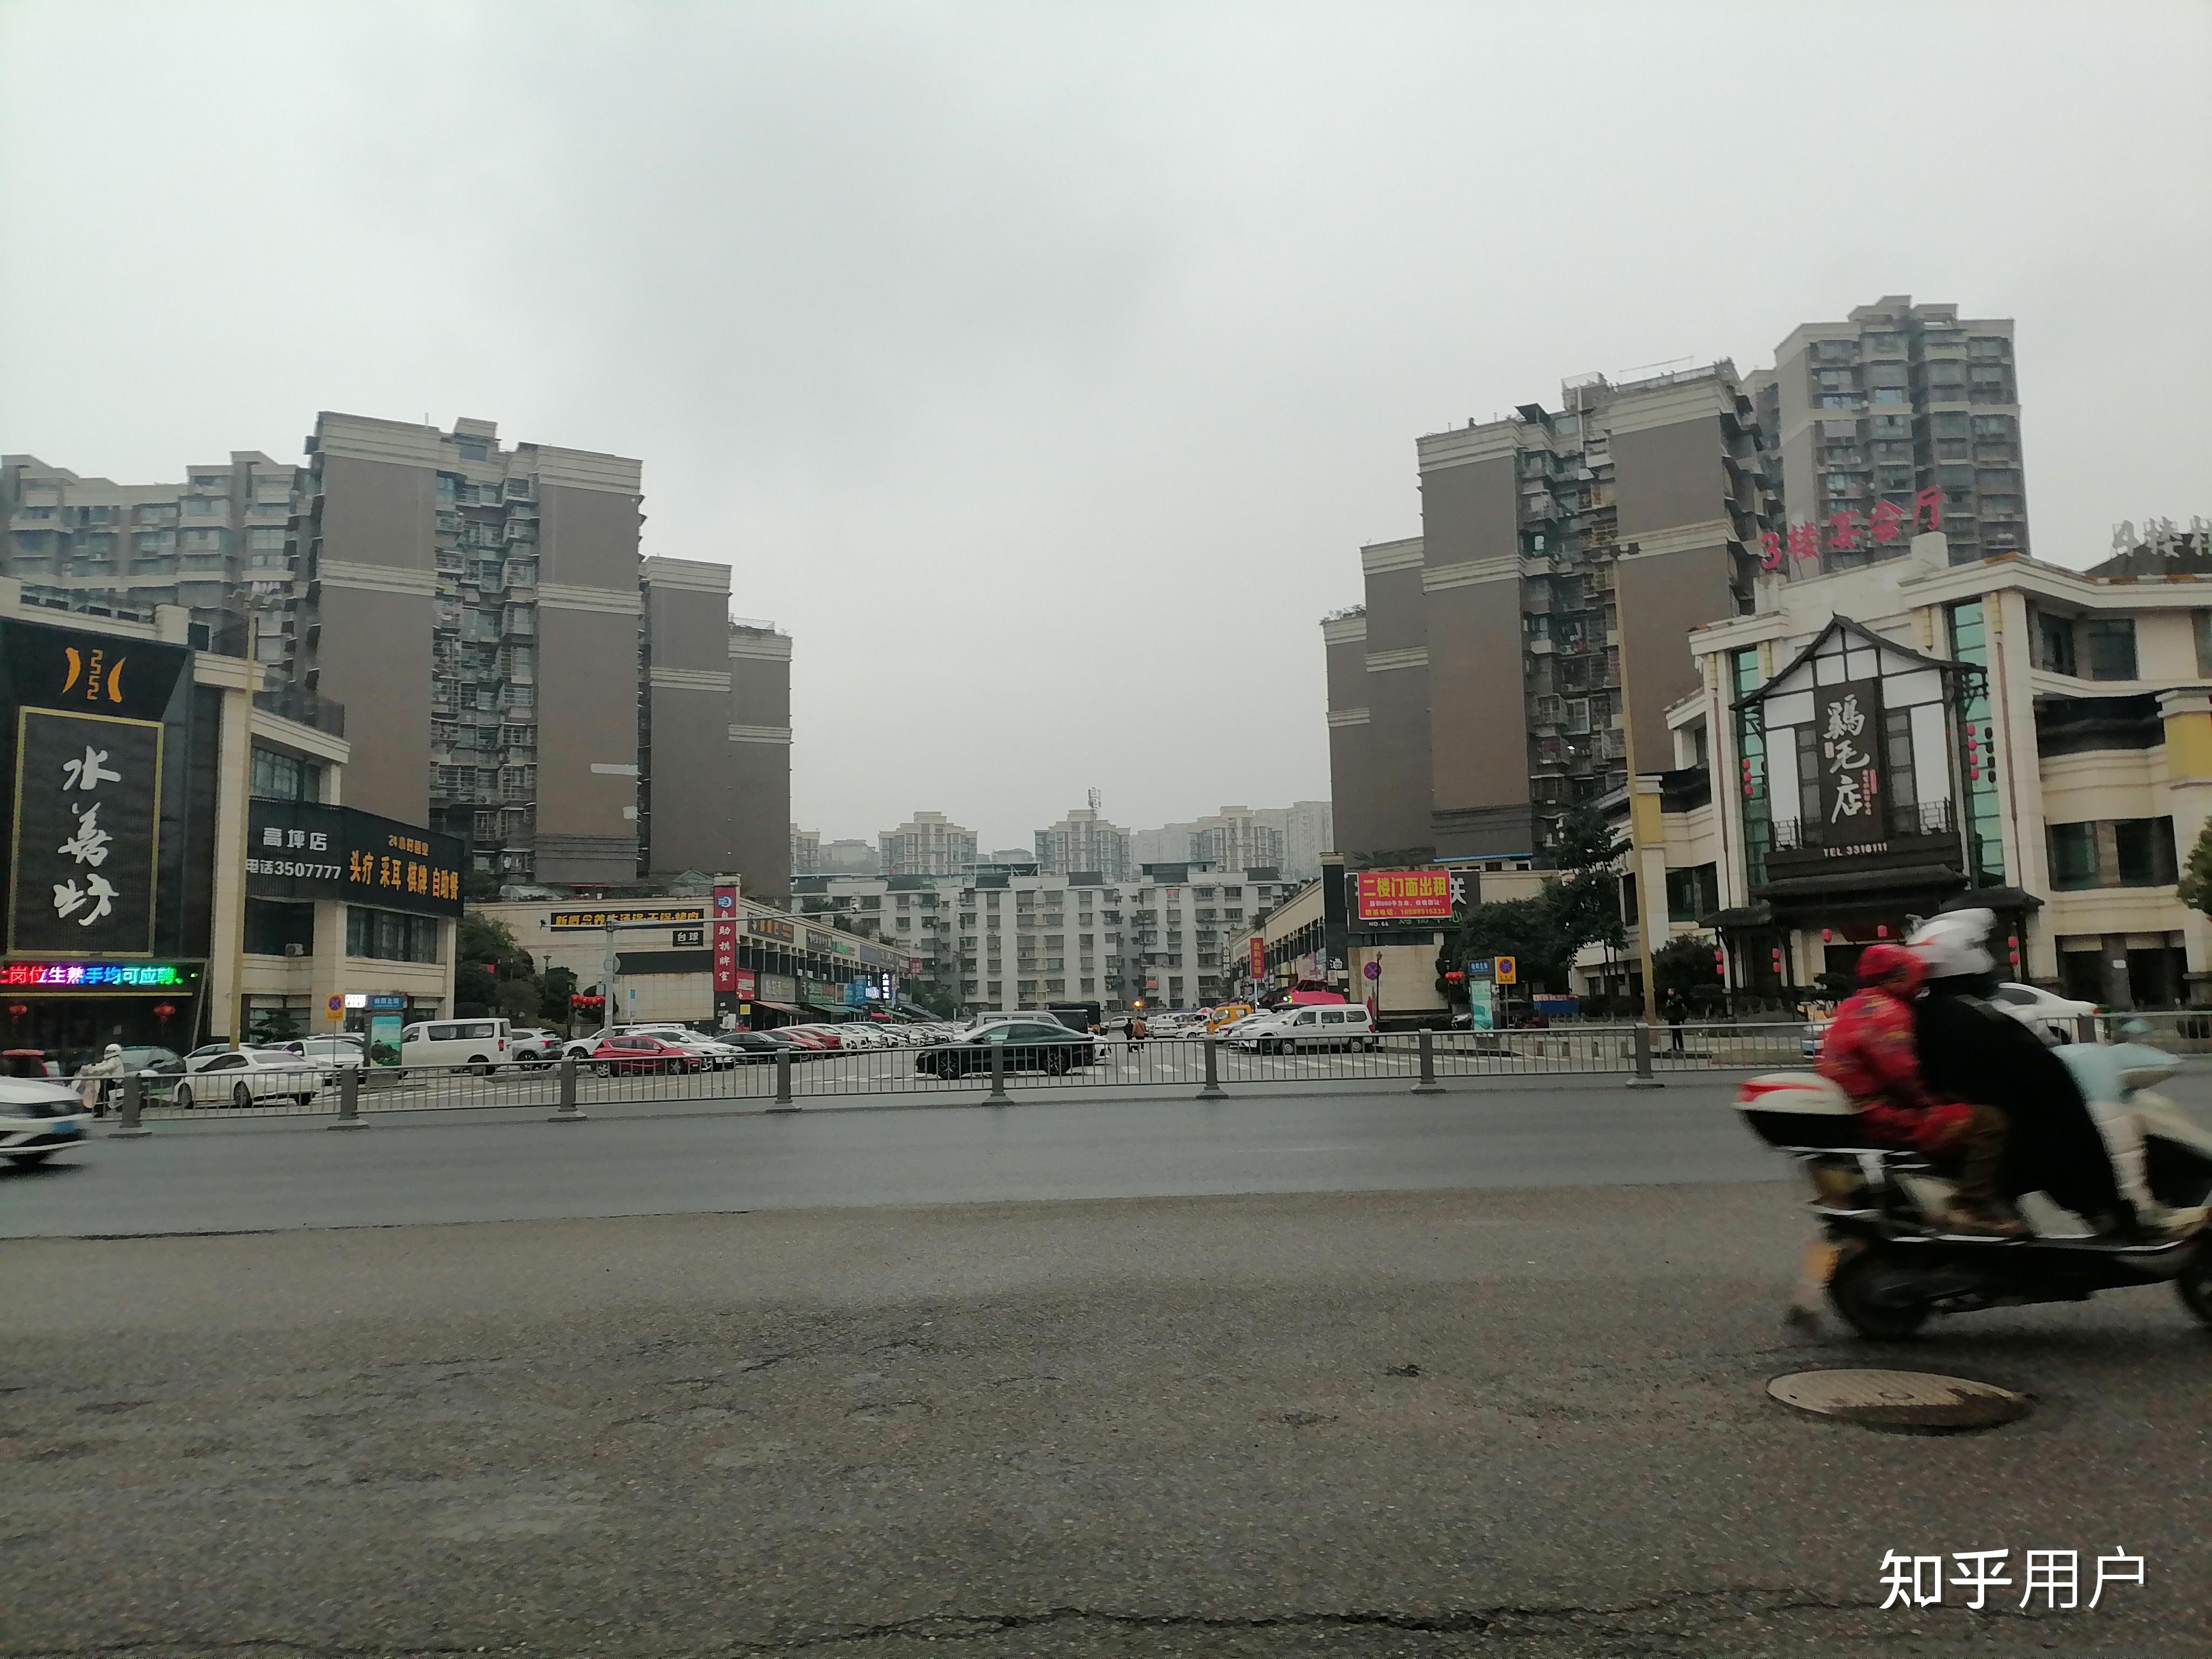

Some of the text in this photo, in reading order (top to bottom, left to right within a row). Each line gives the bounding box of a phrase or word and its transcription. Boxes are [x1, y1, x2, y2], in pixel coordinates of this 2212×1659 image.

[263, 827, 327, 851] 高坪店
[246, 858, 341, 880] 电话3507777
[350, 849, 458, 900] 头疗 采耳 棋牌 自助餐
[1363, 876, 1447, 898] 二楼门面出租
[677, 932, 699, 942] 台球
